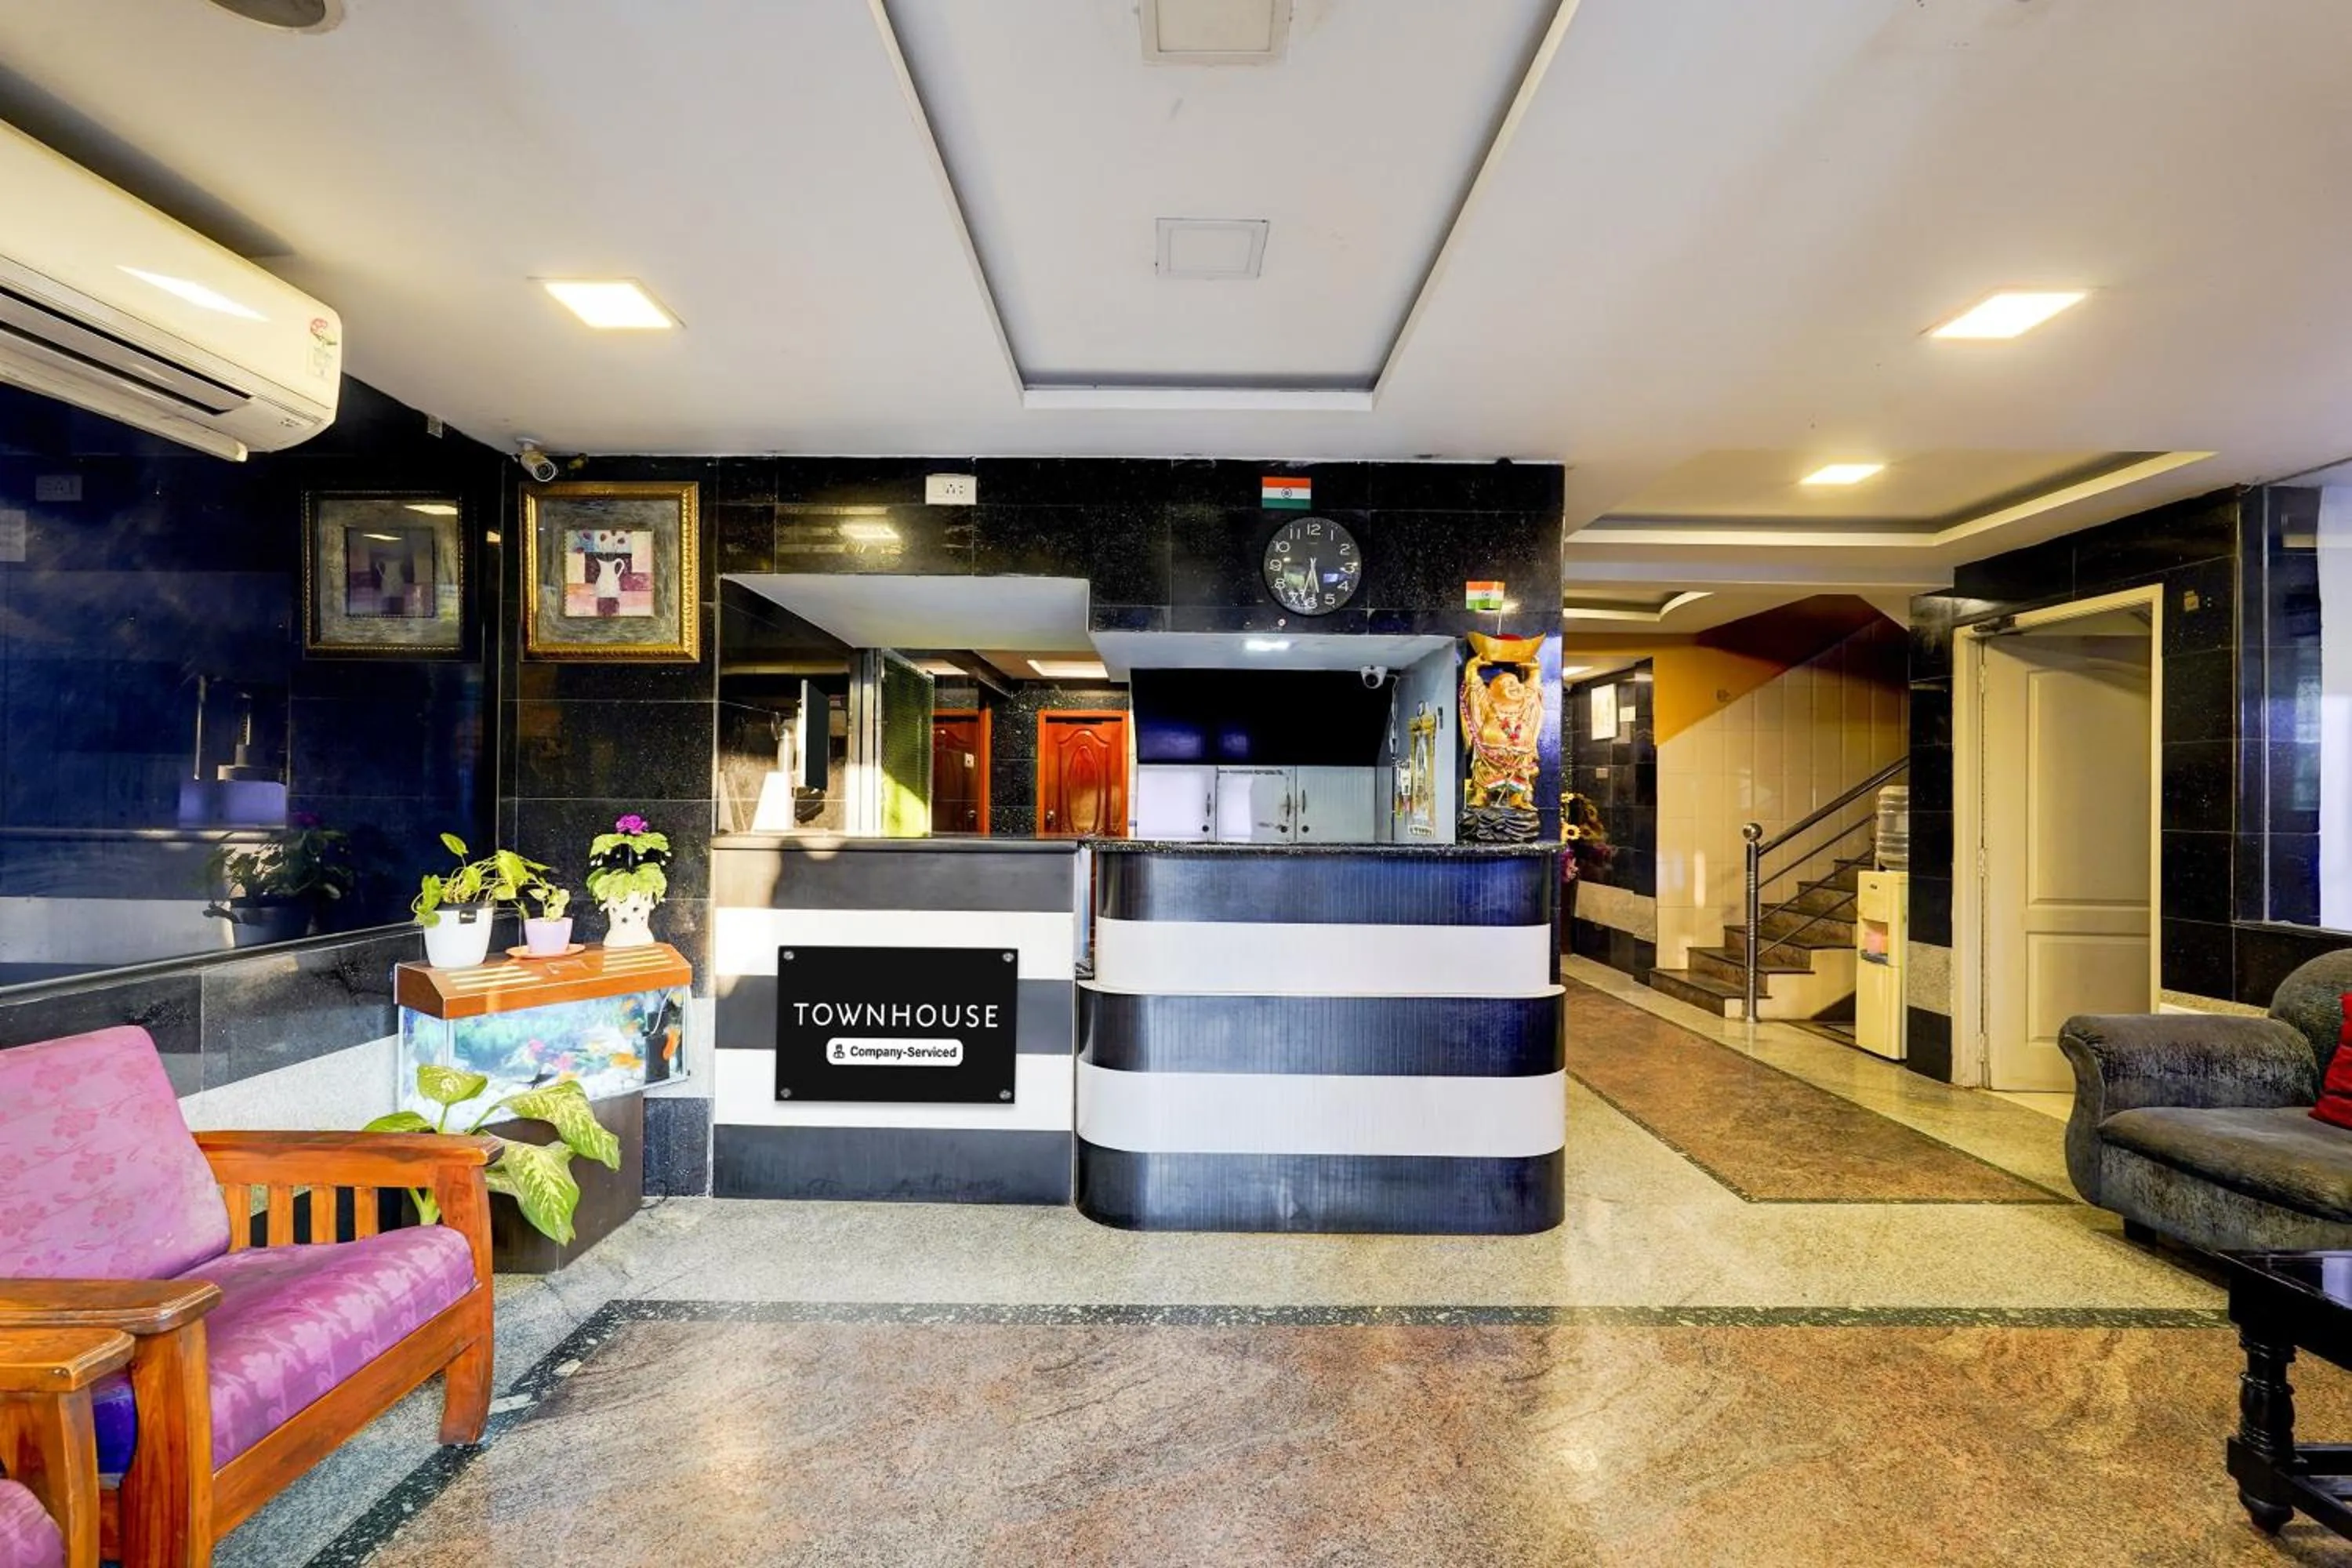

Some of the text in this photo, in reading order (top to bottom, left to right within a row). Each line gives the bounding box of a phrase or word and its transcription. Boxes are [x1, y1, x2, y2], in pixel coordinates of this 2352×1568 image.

[1307, 523, 1322, 536] 12
[1330, 529, 1334, 542] 1
[1340, 543, 1350, 556] 2
[1269, 559, 1282, 572] 9
[1344, 562, 1356, 574] 3
[1275, 578, 1286, 590] 8
[1338, 581, 1349, 592] 4
[1324, 593, 1335, 605] 5
[793, 1003, 999, 1028] TOWNHOUSE
[849, 1045, 958, 1059] Company-Serviced
